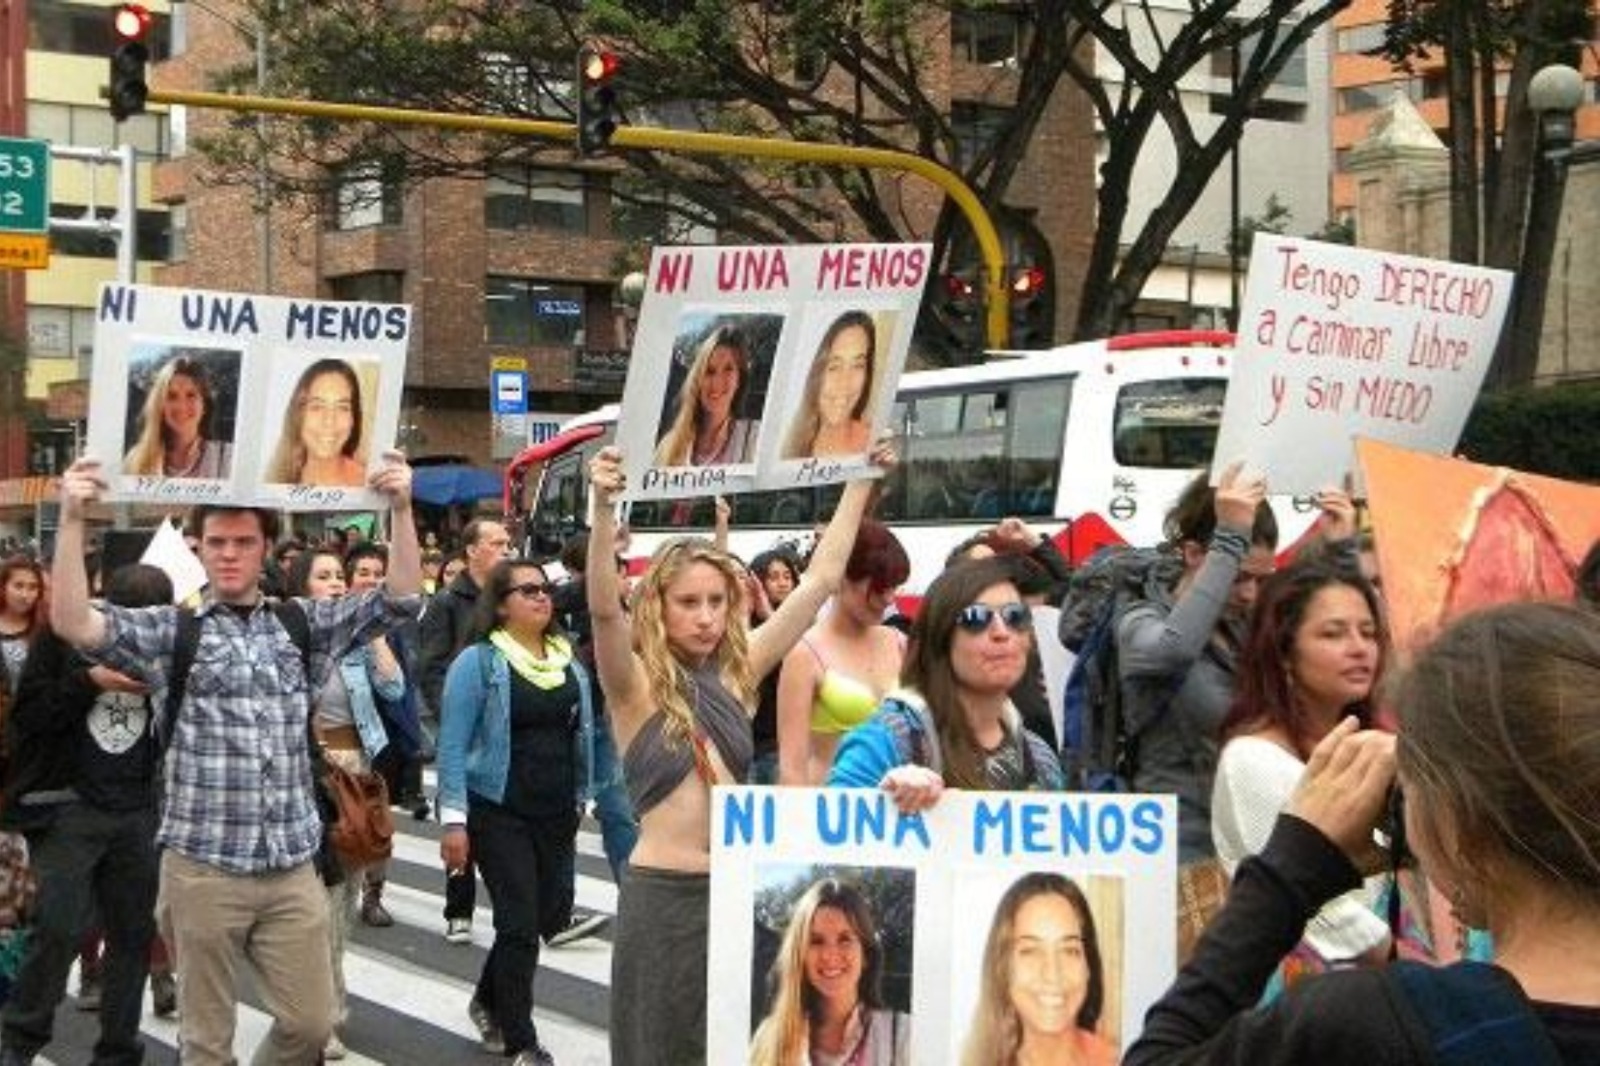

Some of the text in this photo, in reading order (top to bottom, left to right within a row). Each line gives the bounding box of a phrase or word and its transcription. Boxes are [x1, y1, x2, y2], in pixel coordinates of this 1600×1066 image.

[655, 247, 926, 294] NI UNA MENOS
[1278, 246, 1494, 319] Tengo DERECHO
[100, 285, 407, 341] NI UNA MENOS
[1257, 309, 1276, 347] a
[1260, 374, 1286, 426] y
[1356, 375, 1433, 424] MIEDO
[723, 793, 1164, 856] NI UNA MENOS
